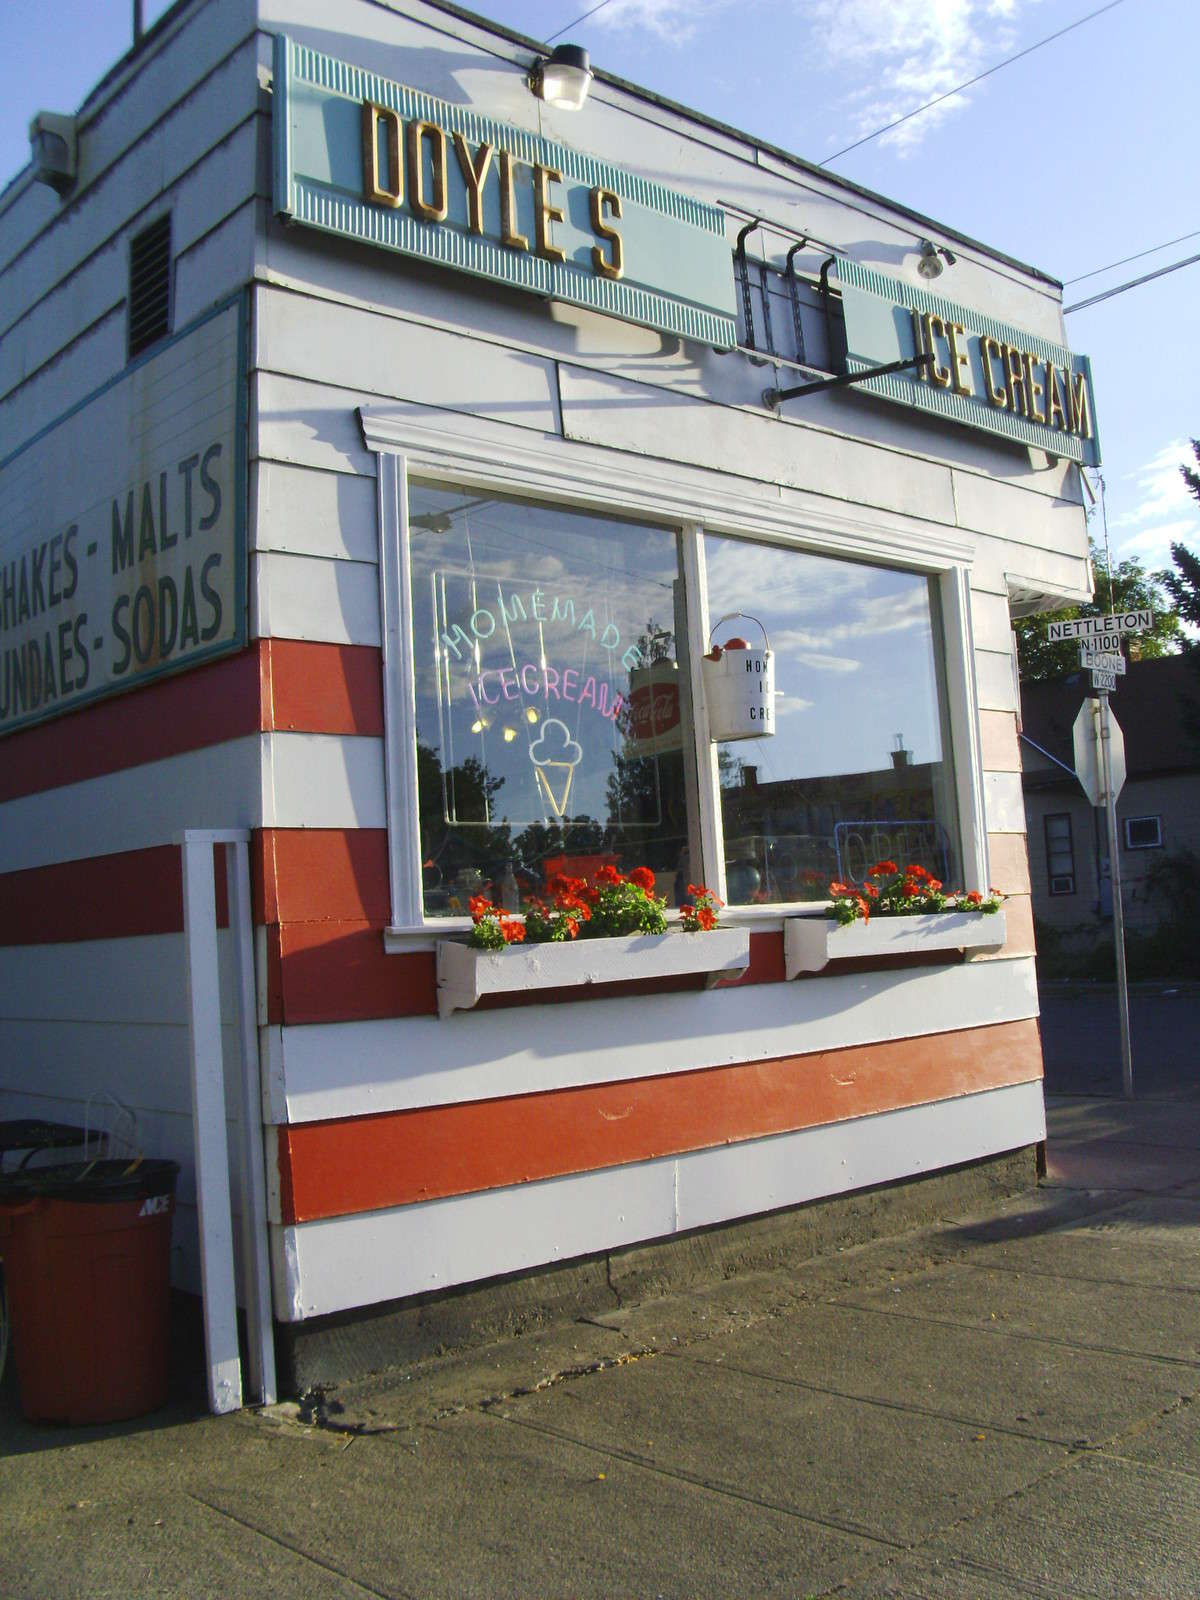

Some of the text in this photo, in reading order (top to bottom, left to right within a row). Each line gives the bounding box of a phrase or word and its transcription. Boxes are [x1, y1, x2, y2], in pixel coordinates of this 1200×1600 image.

[362, 99, 625, 280] DOYLES
[911, 307, 1092, 439] ICE CREAM
[0, 523, 79, 632] HAKES
[111, 442, 223, 575] MALTS
[112, 552, 223, 675] SODAS
[441, 591, 643, 673] HOMEMADE
[1050, 612, 1150, 638] NETTLETON
[1086, 652, 1123, 672] BOONE
